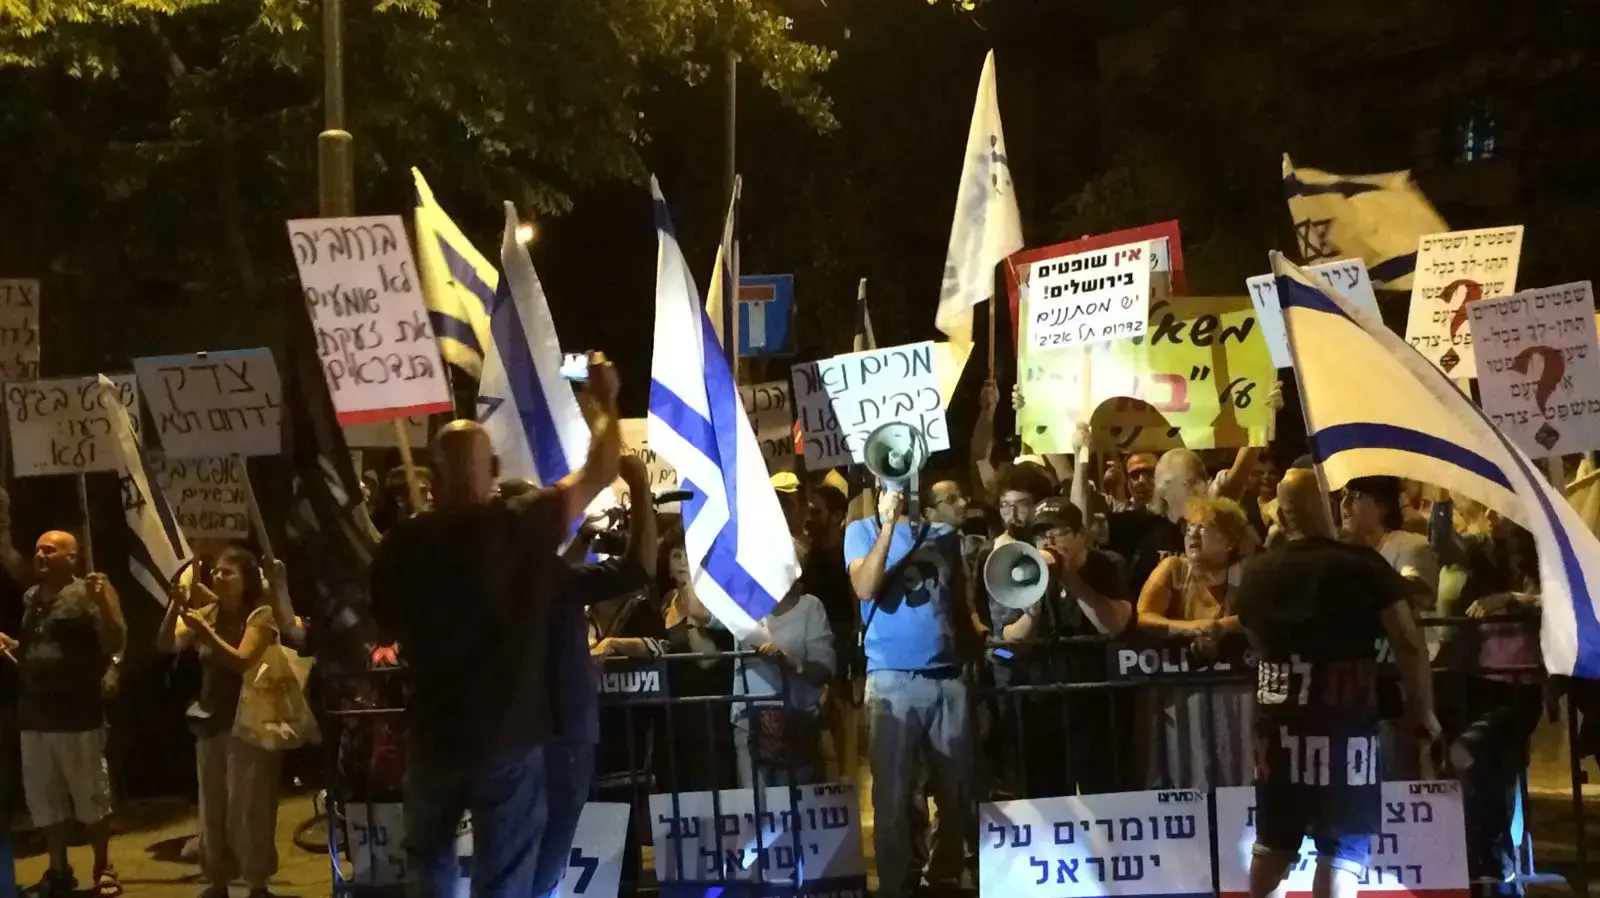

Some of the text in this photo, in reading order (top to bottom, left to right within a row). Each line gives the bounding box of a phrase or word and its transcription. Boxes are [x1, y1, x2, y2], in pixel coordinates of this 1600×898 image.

[378, 260, 412, 293] לא
[1038, 247, 1142, 278] אין שופטים
[1043, 272, 1135, 300] בירושלים!
[394, 310, 432, 343] את
[1036, 294, 1139, 327] יש מסתננים
[1078, 323, 1096, 342] תל
[1102, 320, 1143, 336] בדרום
[860, 346, 932, 385] מרים
[157, 361, 255, 414] צדק
[1218, 377, 1256, 409] על
[852, 386, 941, 428] כיבית
[1117, 648, 1231, 675] POLI
[601, 670, 661, 693] משט
[656, 806, 848, 840] שומרים על
[987, 814, 1196, 849] שומרים על
[700, 843, 818, 873] ישראל
[1029, 853, 1161, 885] ישראל
